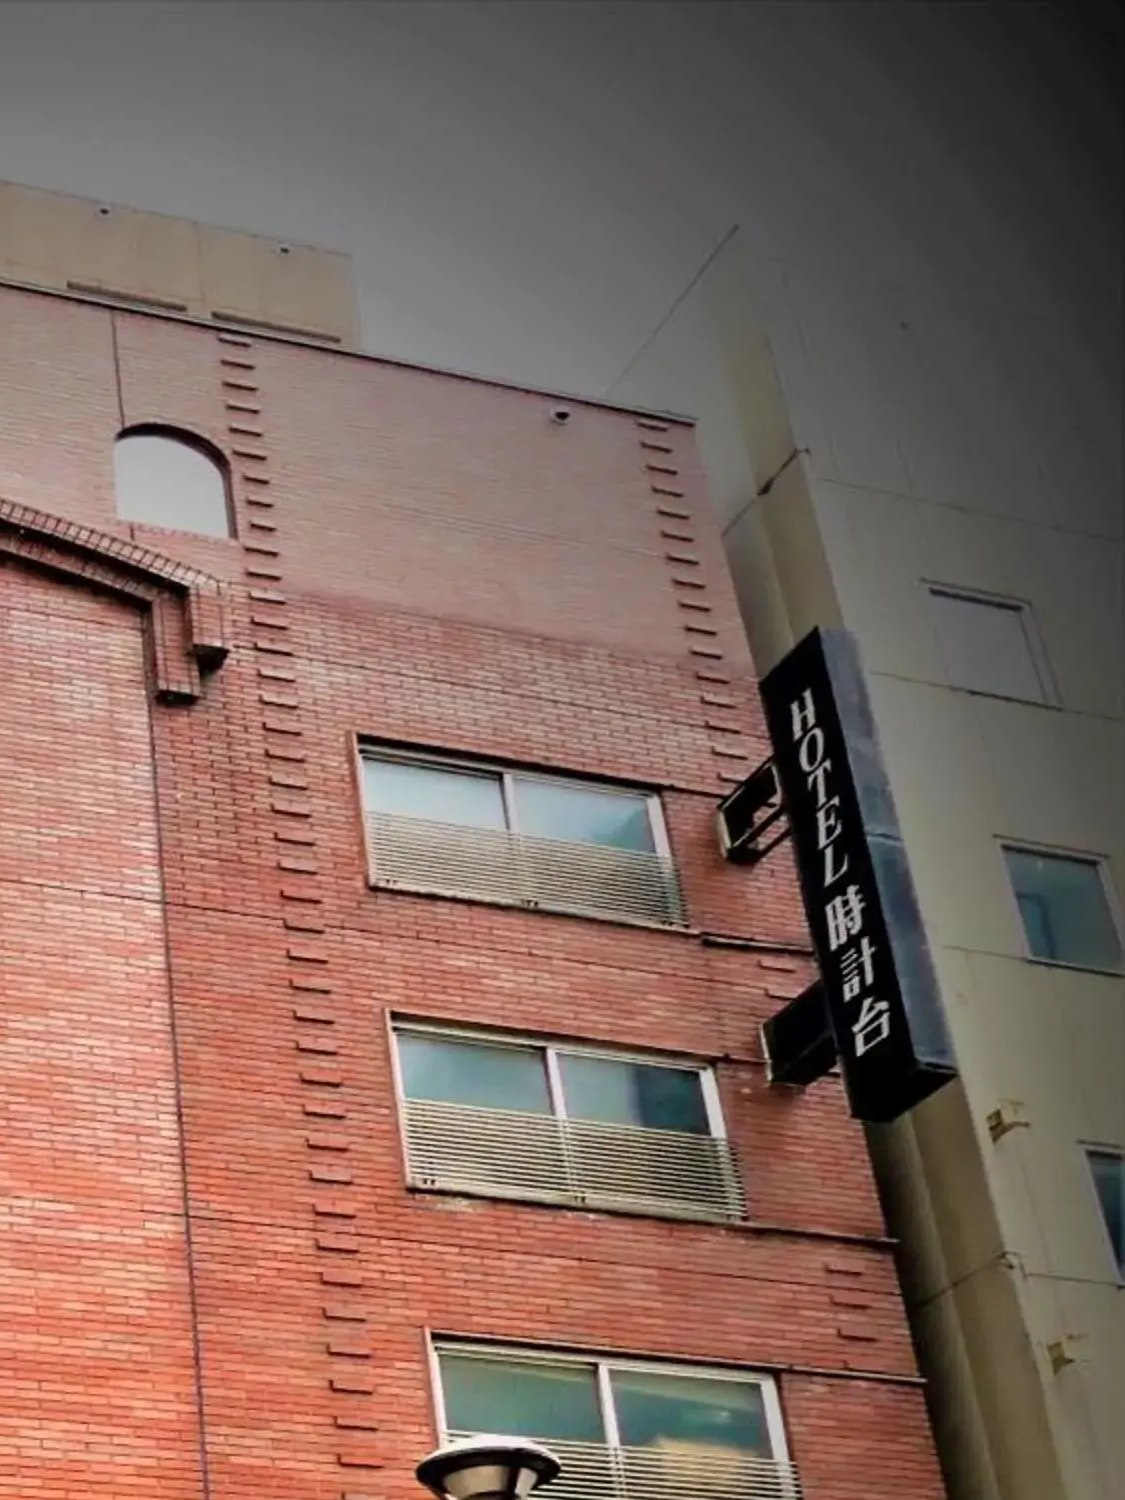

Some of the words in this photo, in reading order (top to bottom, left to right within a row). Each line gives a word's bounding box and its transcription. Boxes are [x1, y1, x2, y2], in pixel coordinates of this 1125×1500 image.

[790, 689, 848, 888] HOTEL
[825, 884, 891, 1058] 時計台
